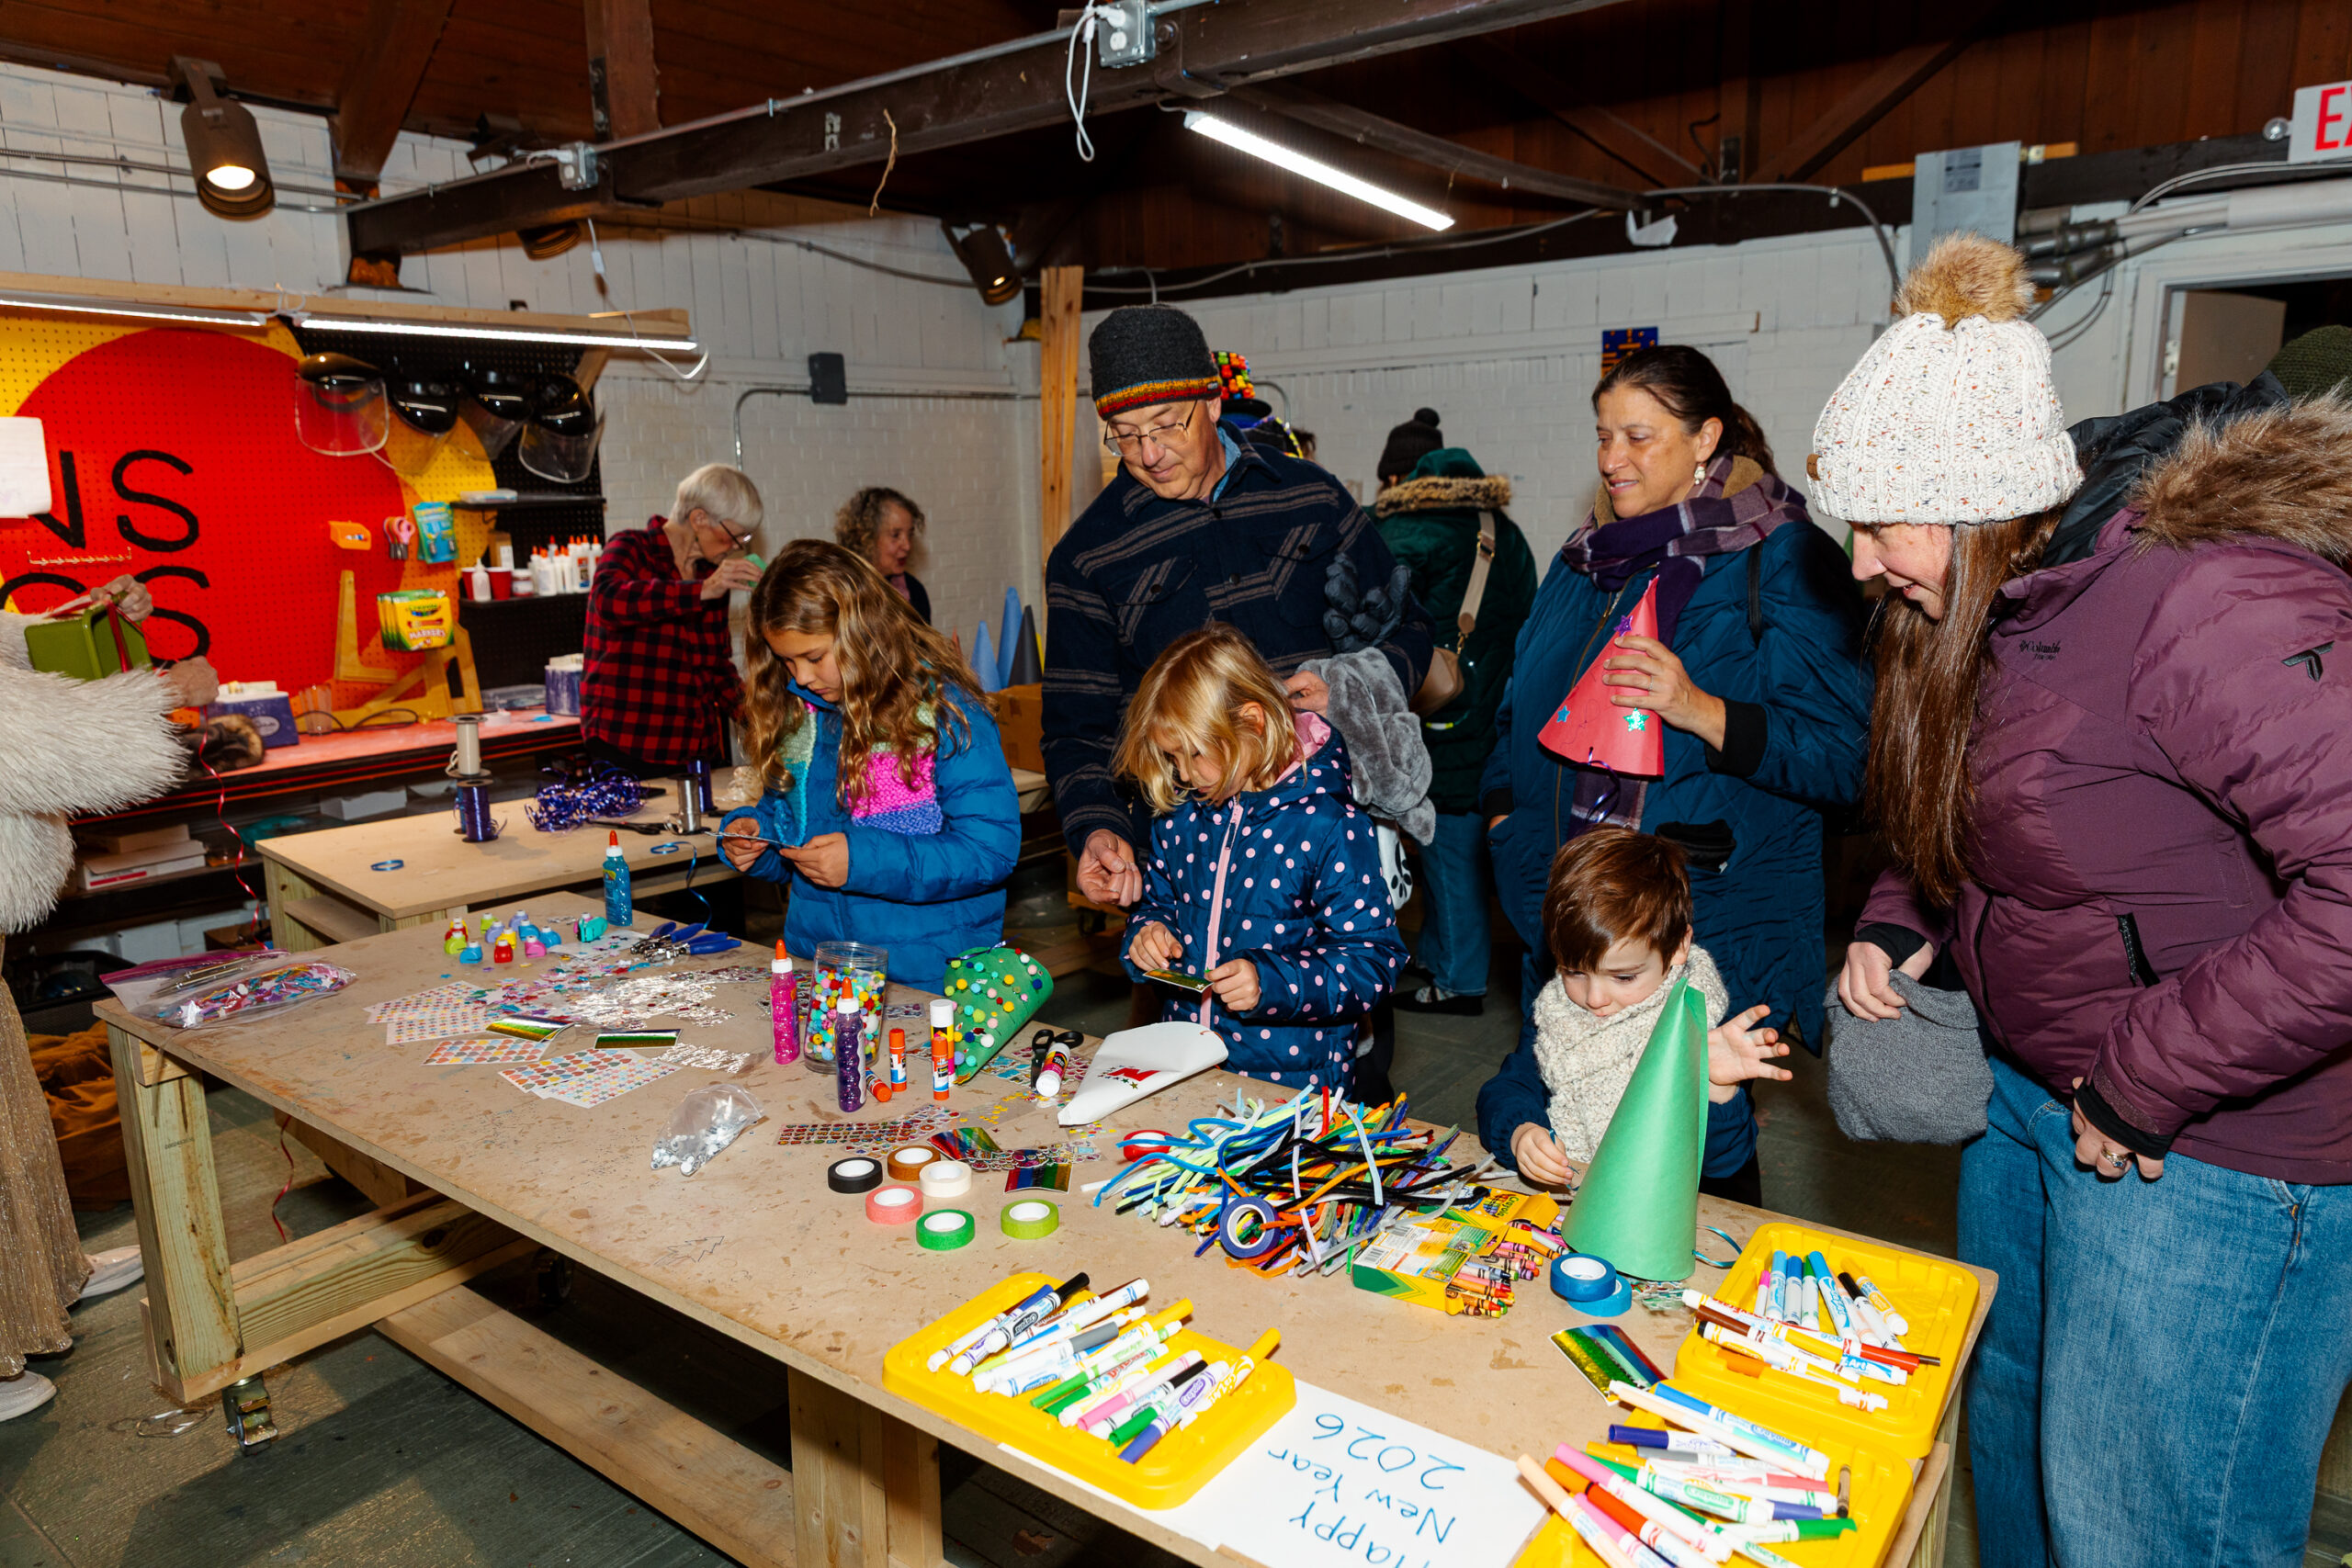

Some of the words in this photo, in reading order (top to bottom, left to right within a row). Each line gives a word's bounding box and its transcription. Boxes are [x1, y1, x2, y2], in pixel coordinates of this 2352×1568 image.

[2314, 84, 2352, 152] E
[1497, 1196, 1520, 1217] Crayola
[1014, 1314, 1037, 1333] Crayola
[1181, 1379, 1204, 1403] Crayola
[1753, 1426, 1792, 1447] Crayola
[1312, 1413, 1466, 1490] 2026
[1267, 1448, 1344, 1504] Year
[1688, 1486, 1728, 1506] Crayola
[1363, 1488, 1456, 1544] New
